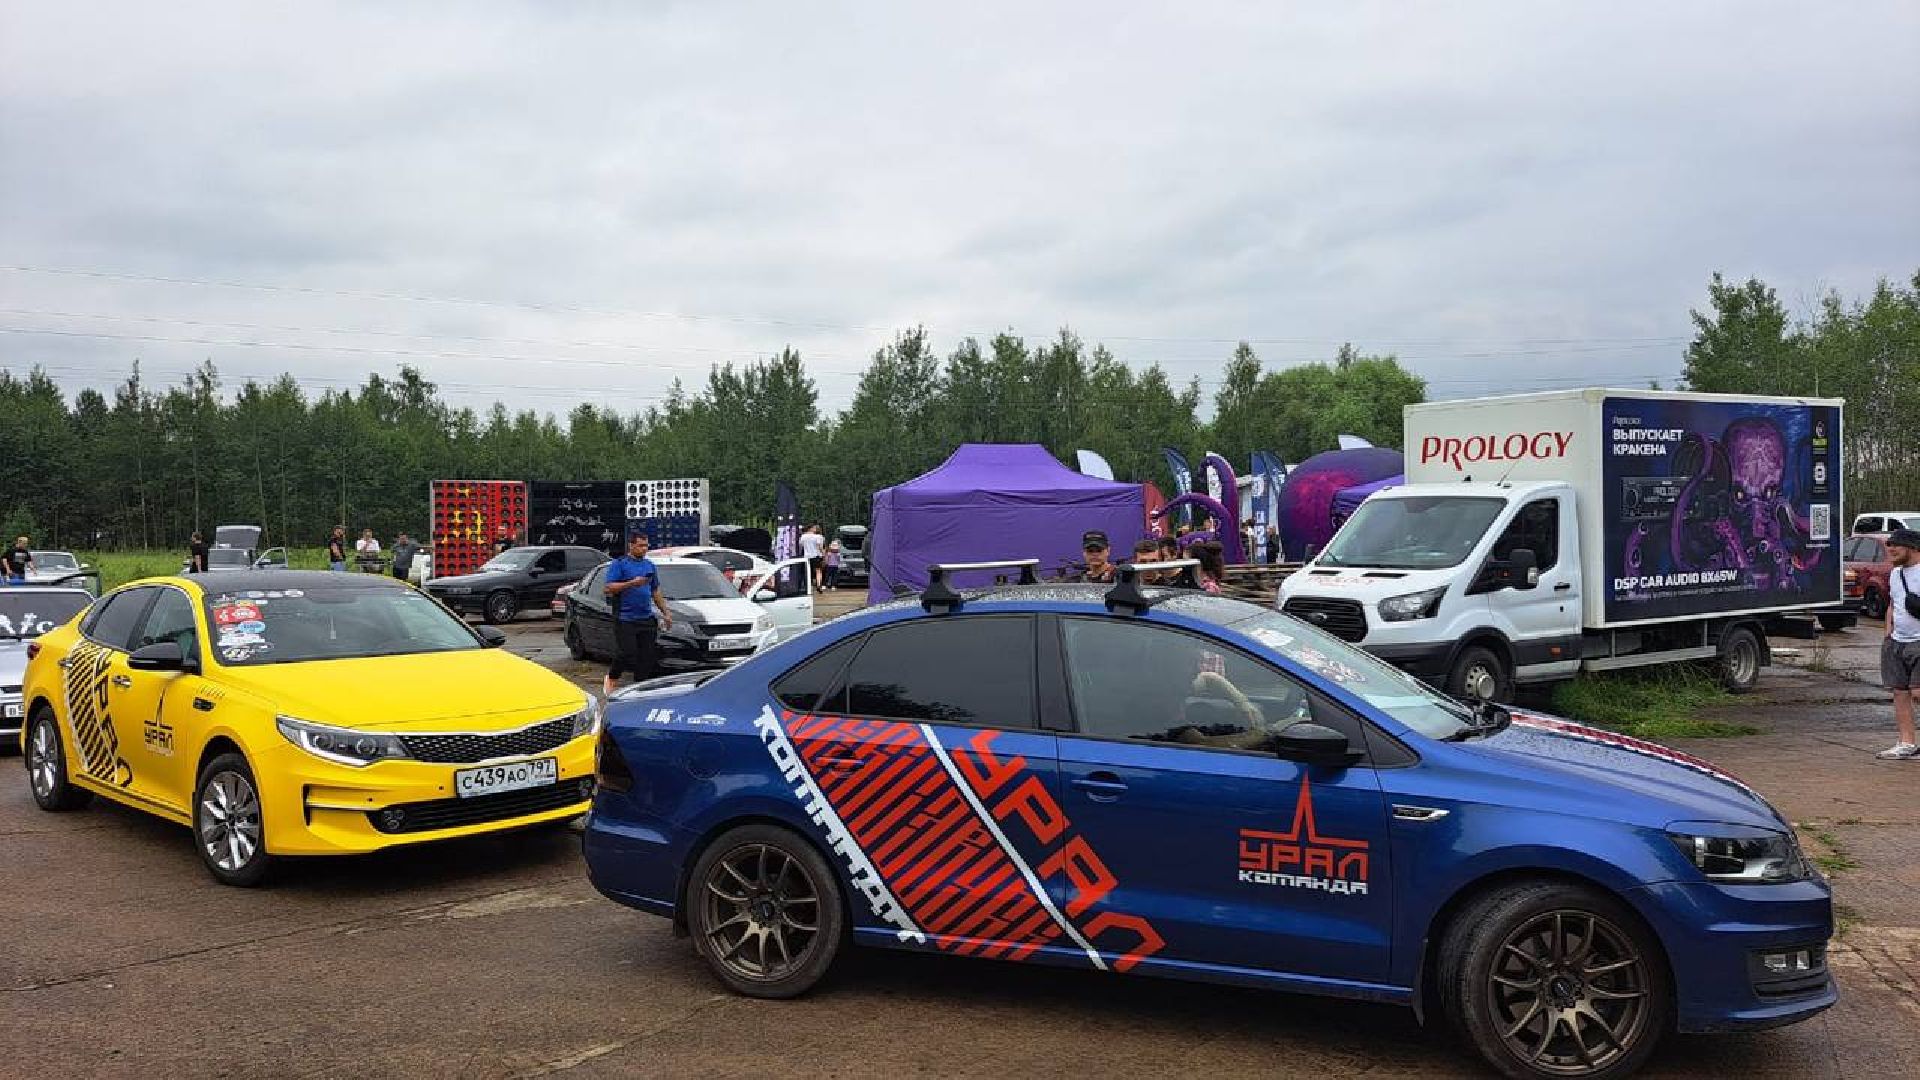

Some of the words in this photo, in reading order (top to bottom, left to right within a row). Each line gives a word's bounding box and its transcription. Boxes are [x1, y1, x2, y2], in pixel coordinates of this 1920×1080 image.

[1613, 429, 1684, 441] ВЫПУСКАЕТ
[1421, 431, 1574, 472] PROLOGY
[1613, 444, 1667, 455] КРАКЕНА
[1614, 577, 1639, 590] DSP
[1640, 574, 1664, 588] CAR
[1665, 572, 1699, 586] AUDIO
[528, 759, 551, 775] 797
[952, 729, 1166, 972] УРАЛ
[1239, 840, 1369, 881] УРАЛ
